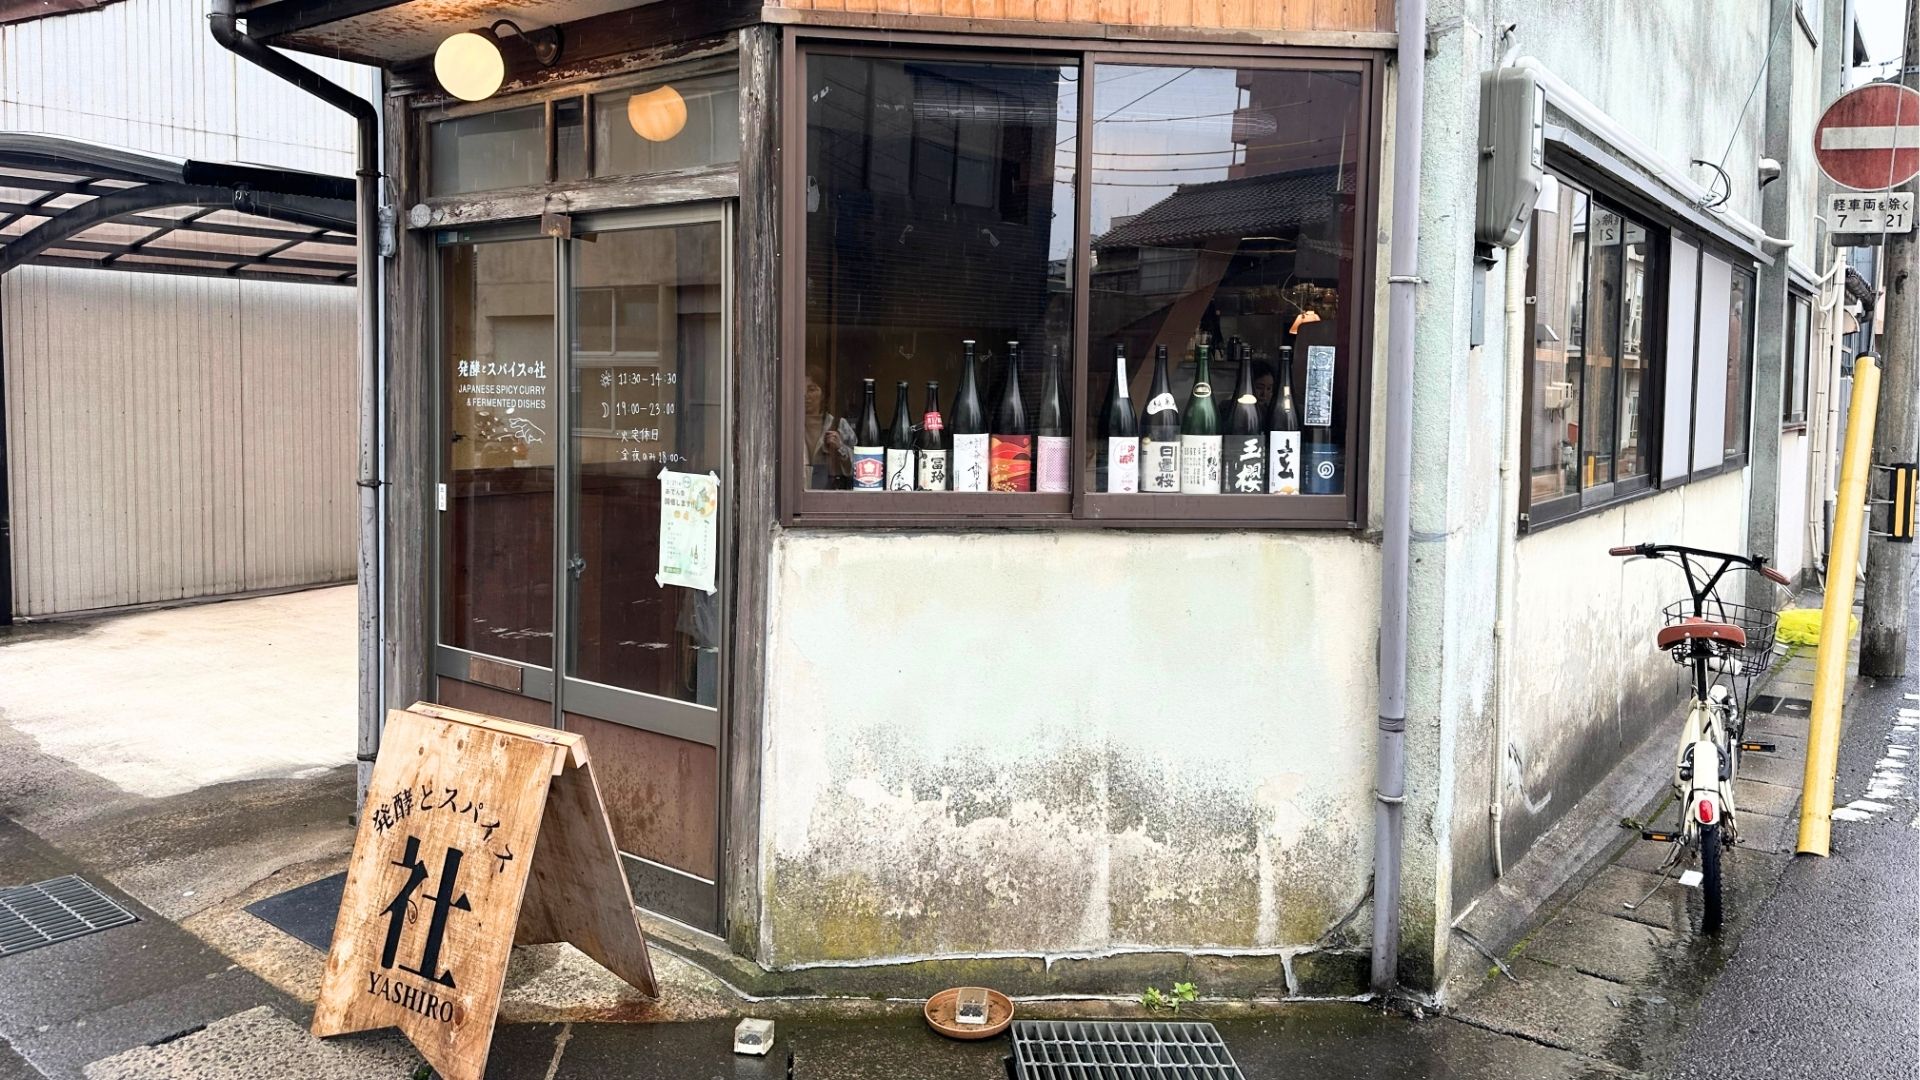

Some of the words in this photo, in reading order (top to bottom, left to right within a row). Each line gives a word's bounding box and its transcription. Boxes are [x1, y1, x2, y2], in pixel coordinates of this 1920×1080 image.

[1833, 197, 1909, 212] 軽車両を除く
[458, 359, 547, 379] 発酵とスパイスの社
[459, 384, 495, 394] JAPANESE
[496, 385, 518, 394] SPICY
[519, 385, 546, 395] CURRY
[472, 398, 517, 408] FERMENTED
[517, 399, 546, 409] DISHES
[379, 834, 473, 989] 社
[368, 971, 455, 1023] YASHIRO
